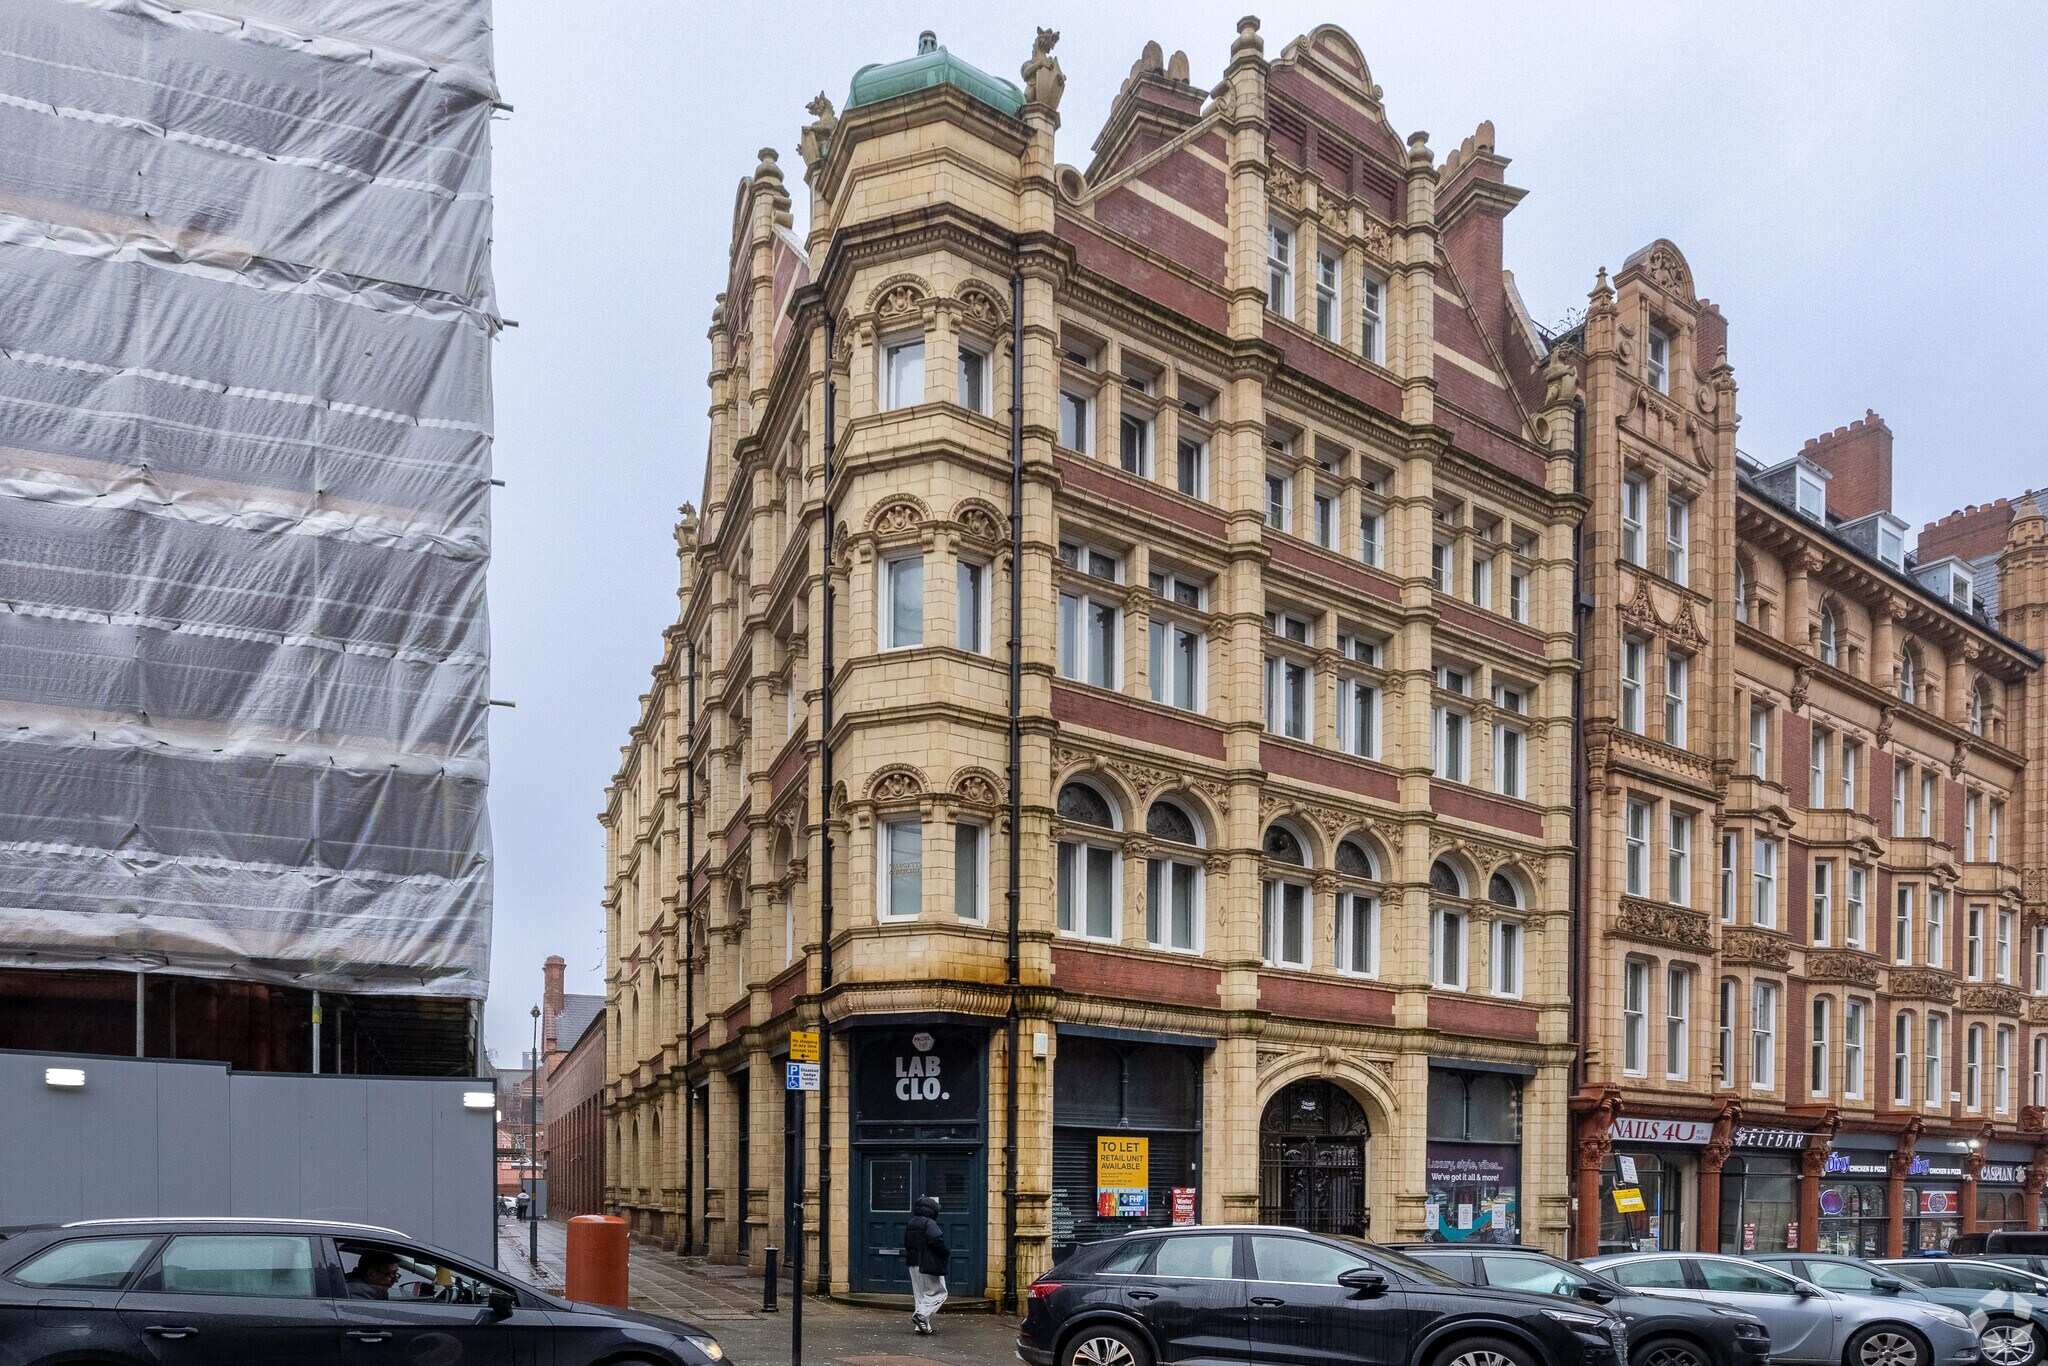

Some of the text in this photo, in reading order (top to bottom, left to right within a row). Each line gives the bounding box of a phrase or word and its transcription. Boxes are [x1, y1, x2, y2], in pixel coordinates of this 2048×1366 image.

[791, 1066, 798, 1074] P
[896, 1056, 941, 1077] LAB
[896, 1078, 950, 1100] CLO.
[1612, 1120, 1696, 1141] NAILS 4U
[1747, 1129, 1804, 1147] ELFBAR
[1101, 1142, 1140, 1152] TO LET
[1427, 1158, 1455, 1171] Luxury,
[1457, 1159, 1478, 1171] style,
[1451, 1173, 1461, 1182] got
[1981, 1166, 2012, 1180] CASPIAN
